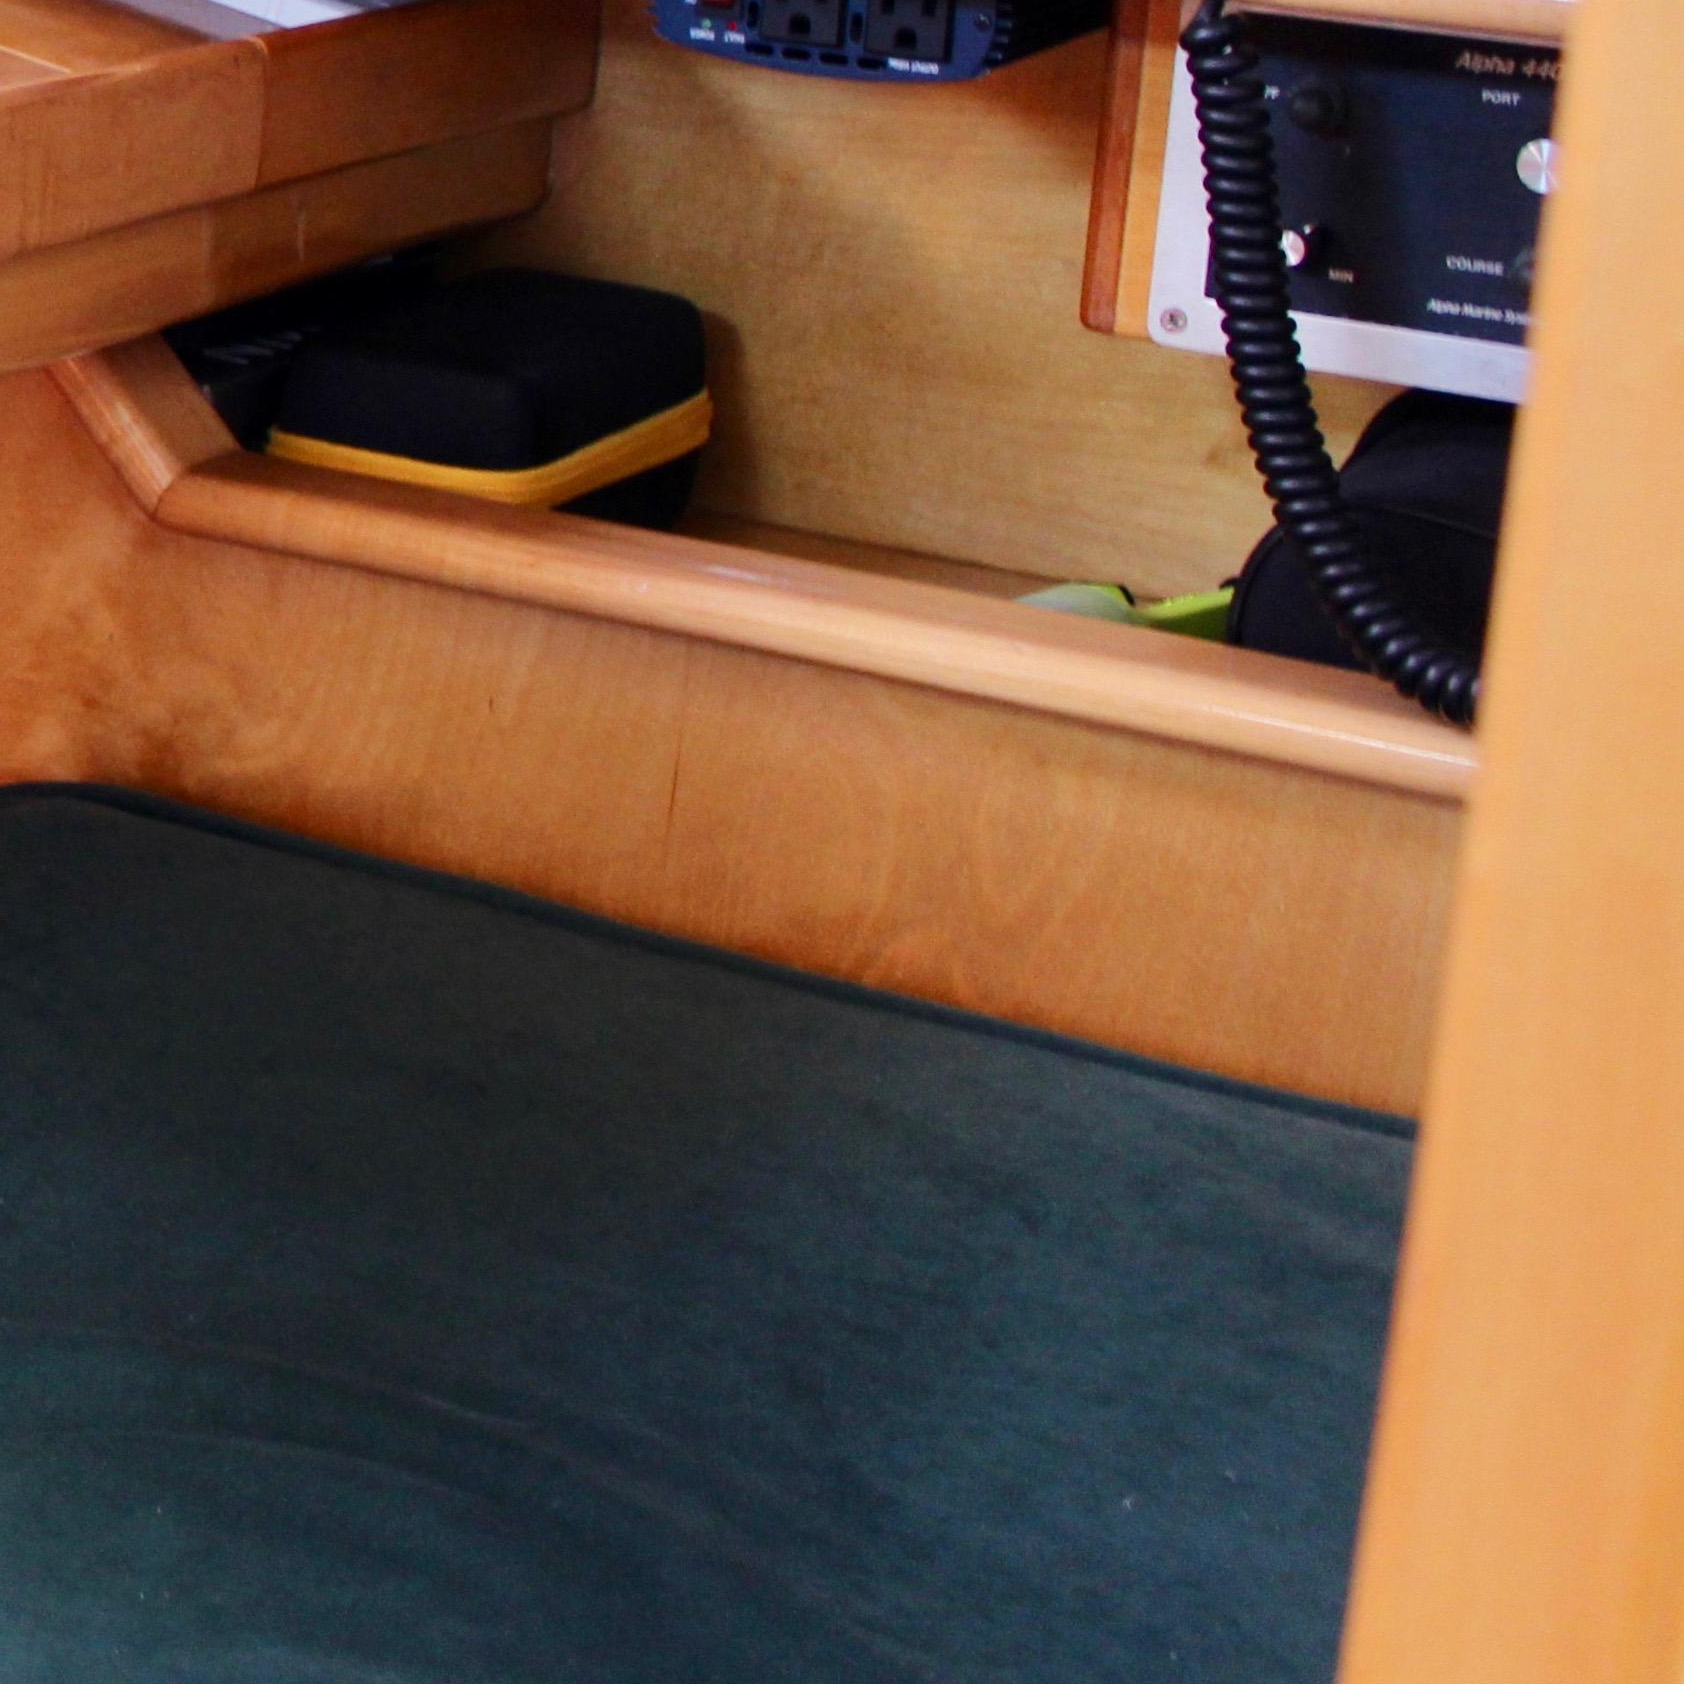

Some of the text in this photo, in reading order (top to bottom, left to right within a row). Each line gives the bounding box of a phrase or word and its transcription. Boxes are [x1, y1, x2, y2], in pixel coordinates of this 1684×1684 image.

[1455, 50, 1515, 74] Alpha
[1481, 88, 1520, 106] PORT
[1446, 256, 1505, 277] COURSE
[1329, 270, 1354, 284] MIN
